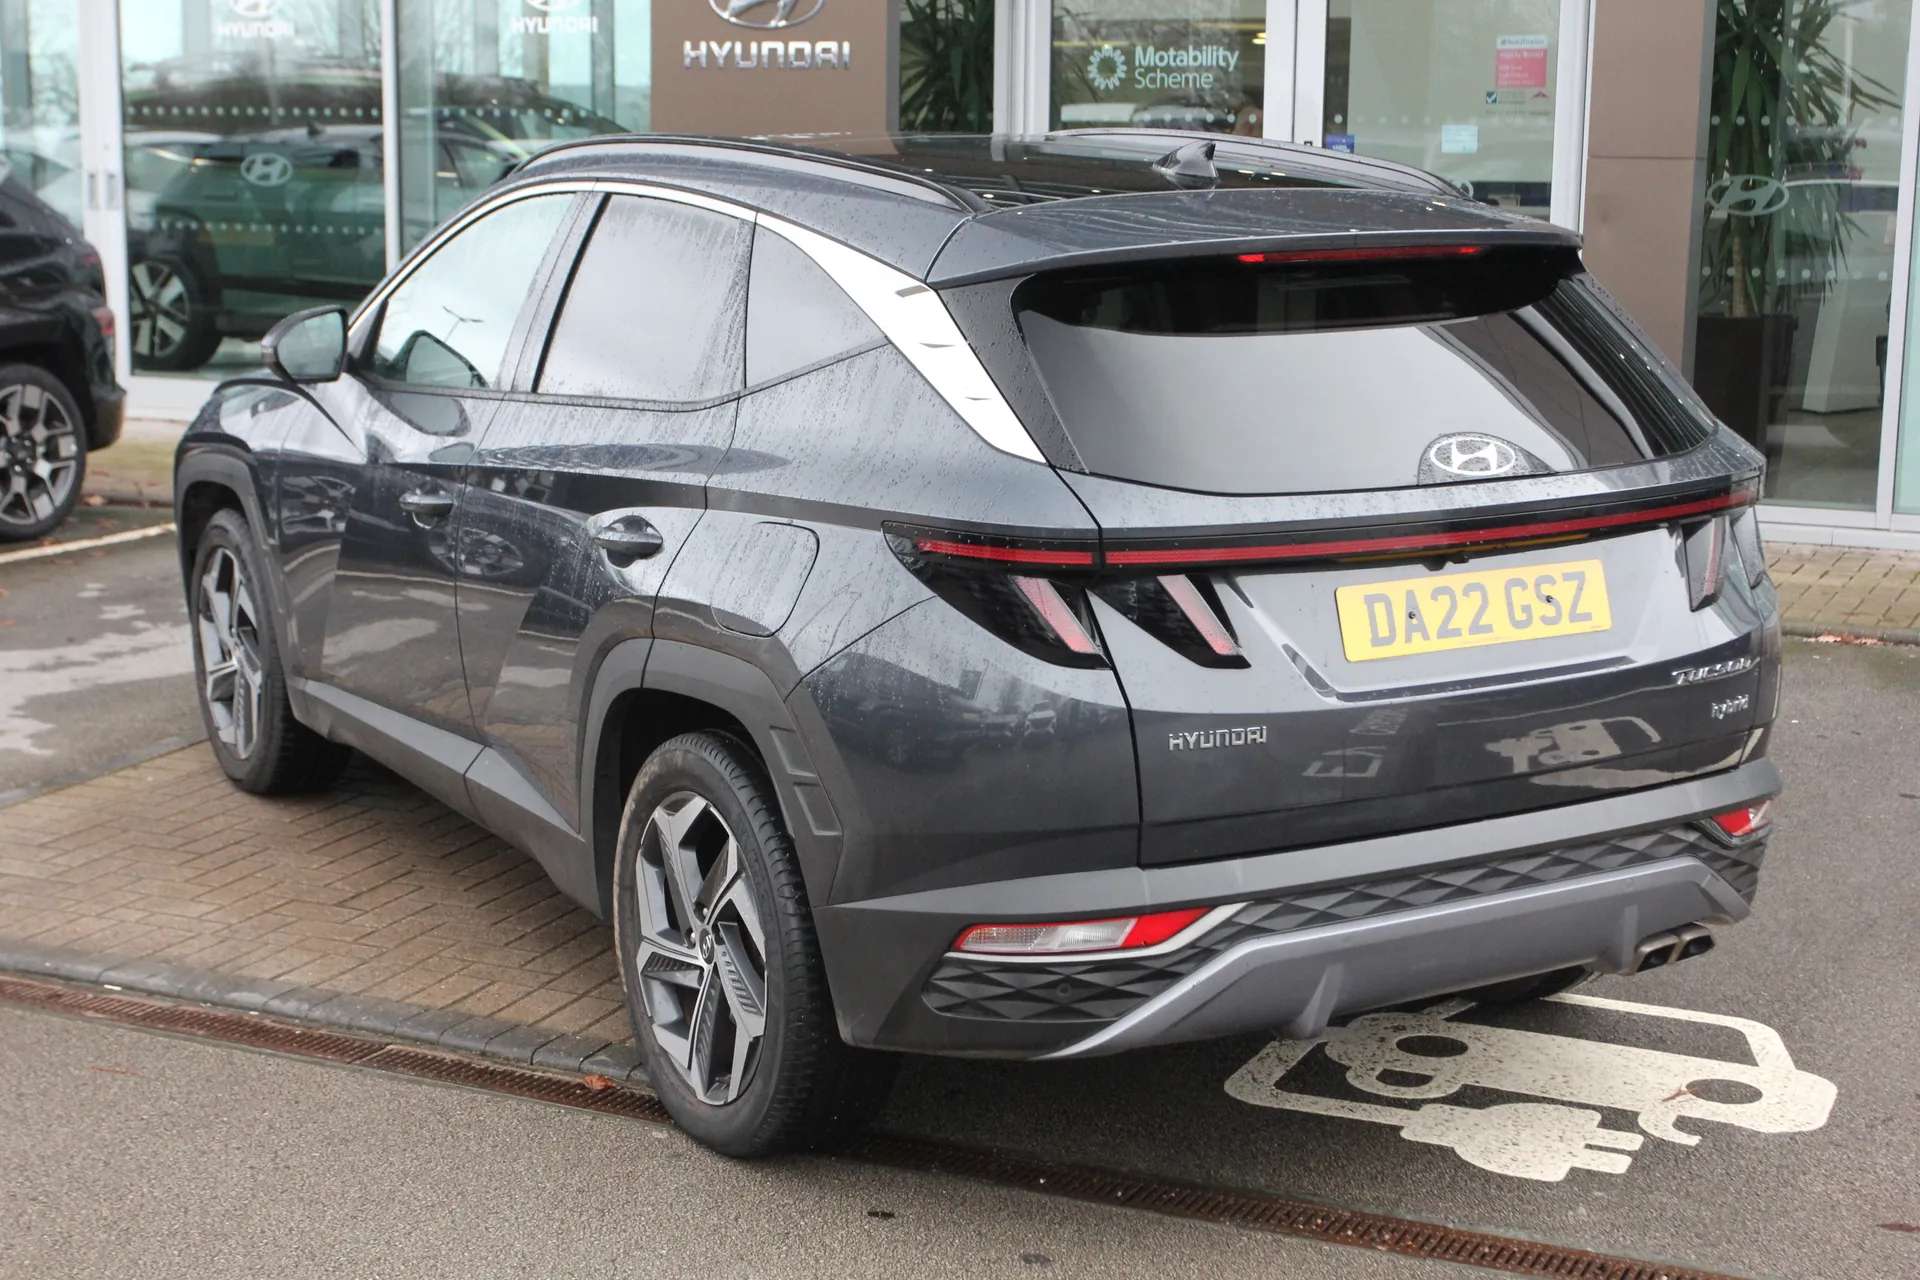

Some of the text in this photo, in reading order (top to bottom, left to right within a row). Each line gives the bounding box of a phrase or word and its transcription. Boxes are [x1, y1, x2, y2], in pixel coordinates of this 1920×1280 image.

[510, 15, 599, 34] HYUNDAI
[683, 40, 850, 70] HYUNDAI
[1134, 45, 1240, 72] Motability
[1134, 68, 1214, 89] Scheme
[1363, 571, 1593, 648] DA22 GSZ
[1711, 694, 1750, 720] hybrid
[1168, 725, 1267, 751] HYUNDAI
